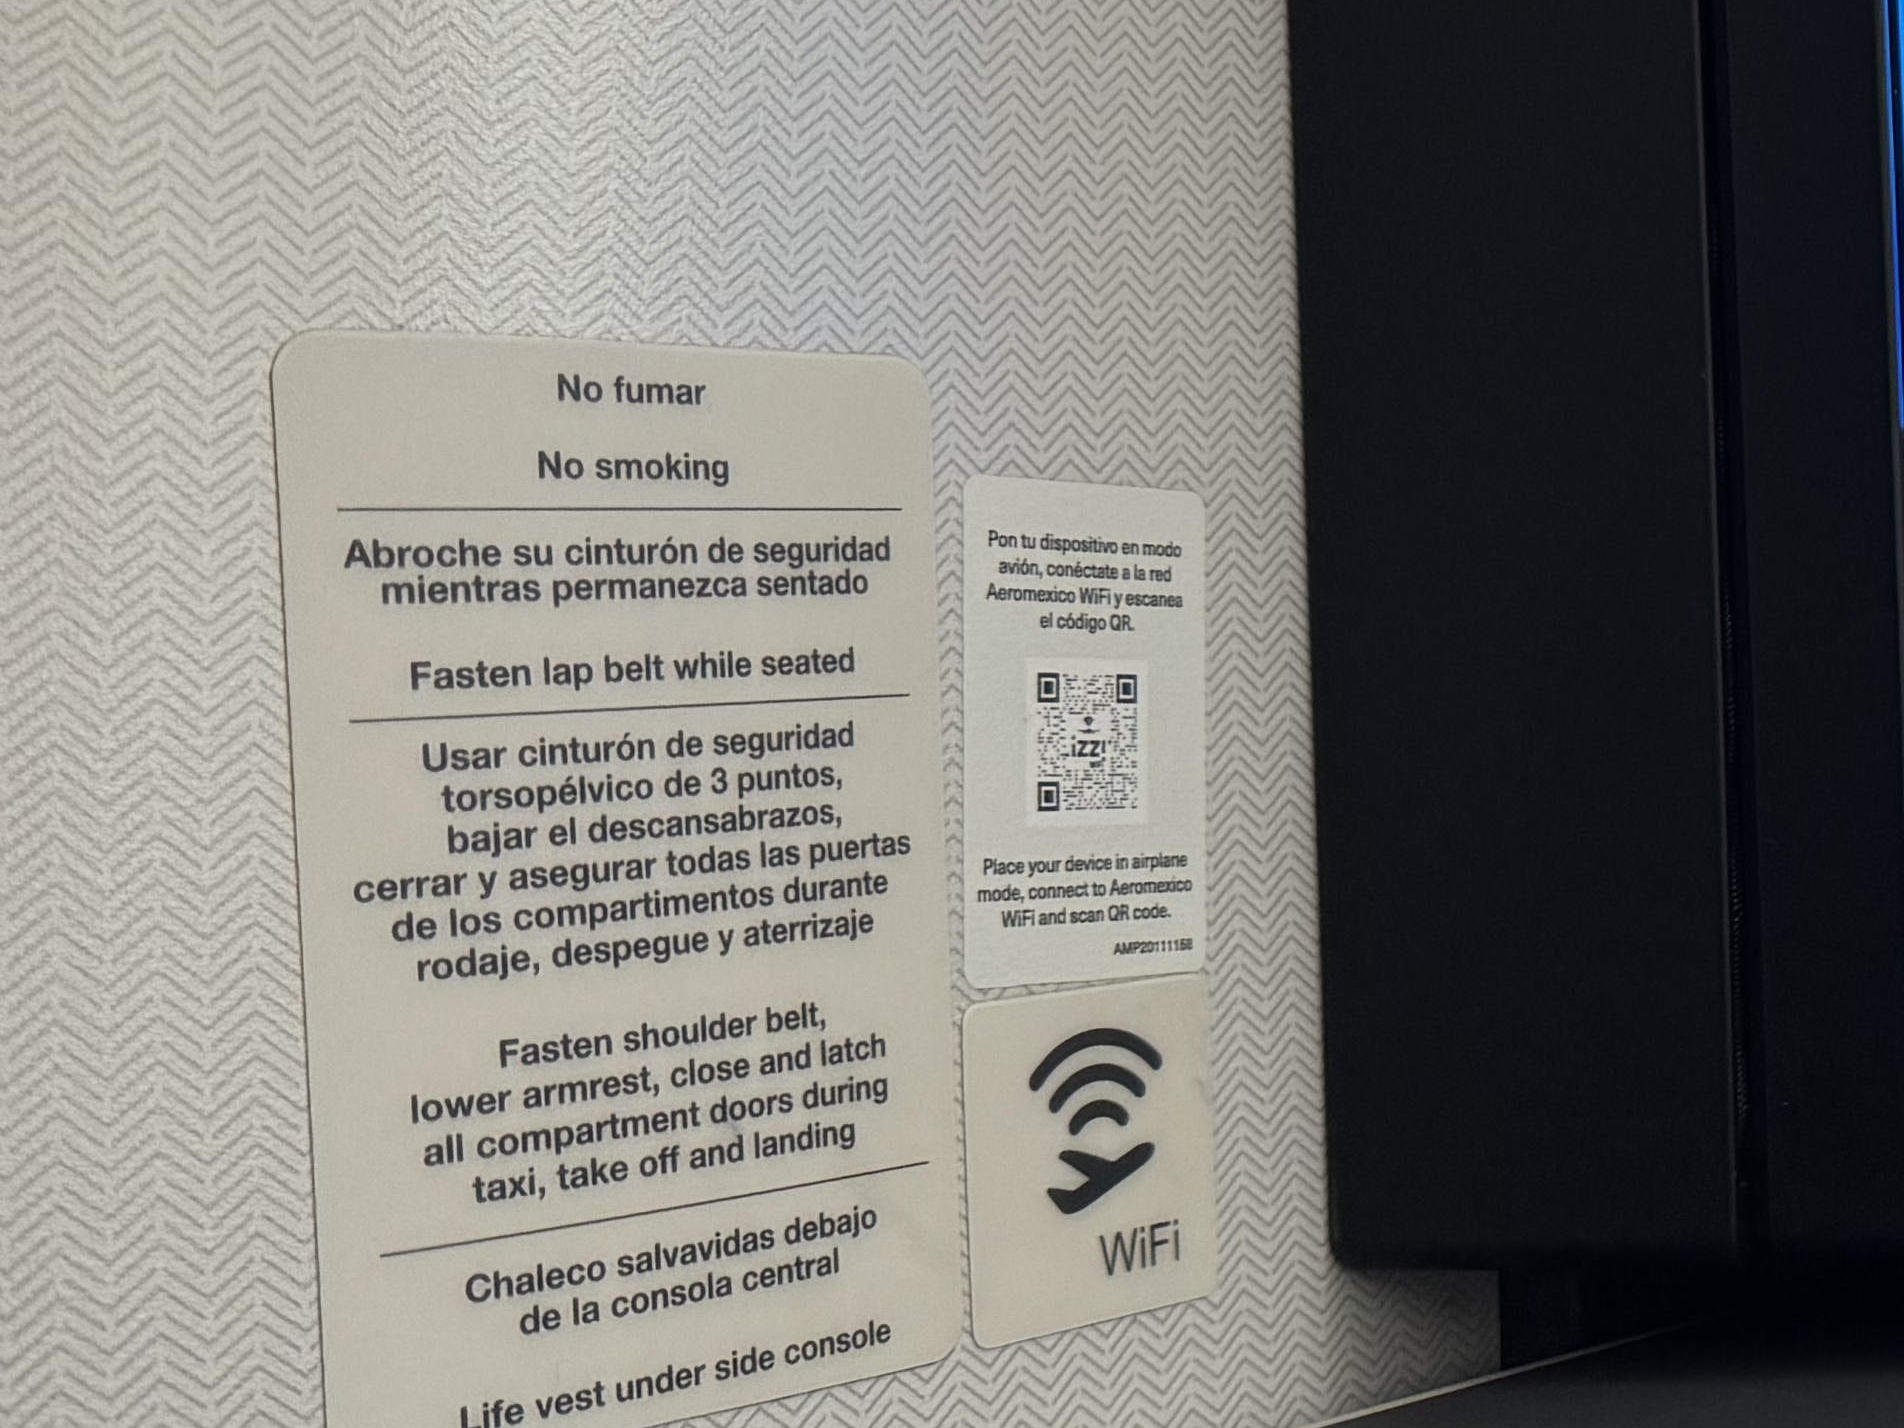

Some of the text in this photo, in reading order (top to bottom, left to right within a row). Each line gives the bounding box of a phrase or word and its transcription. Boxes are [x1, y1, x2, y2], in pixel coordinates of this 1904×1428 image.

[557, 372, 707, 406] No fumar
[537, 450, 730, 488] No smoking
[343, 535, 891, 570] Abroche su cinturón de seguridad
[988, 530, 1182, 557] Pon tu dispositivo en modo
[381, 567, 869, 608] mientras permanezca sentado
[986, 583, 1183, 609] Aeromexico WiFi y escanea
[999, 558, 1172, 582] avión, conéctate a la red
[1040, 613, 1135, 633] el código QR.
[410, 645, 855, 692] Fasten lap belt while seated
[422, 719, 854, 773] Usar cinturón de seguridad
[440, 763, 843, 814] torsopélvico de 3 puntos,
[447, 803, 842, 858] bajar el descansabrazos,
[353, 832, 911, 904] cerrar y asegurar todas las puertas
[977, 877, 1193, 902] mode, connect to Aeromexico
[984, 853, 1188, 877] Place your device in airplane
[391, 870, 889, 943] de los compartimentos durante
[1001, 904, 1171, 927] WiFi and scan QR code.
[417, 907, 874, 982] rodaje, despegue y aterrizaje
[499, 1001, 826, 1069] Fasten shoulder belt,
[410, 1032, 886, 1125] lower armrest, close and latch
[423, 1075, 888, 1167] all compartment doors during
[471, 1121, 856, 1204] taxi, take off and landing
[465, 1205, 878, 1304] Chaleco salvavidas debajo
[1099, 1219, 1180, 1276] WiFi
[519, 1246, 840, 1336] de la consola central
[535, 1380, 606, 1419] vest
[615, 1363, 707, 1403] under
[714, 1346, 775, 1382] side
[784, 1319, 891, 1366] console
